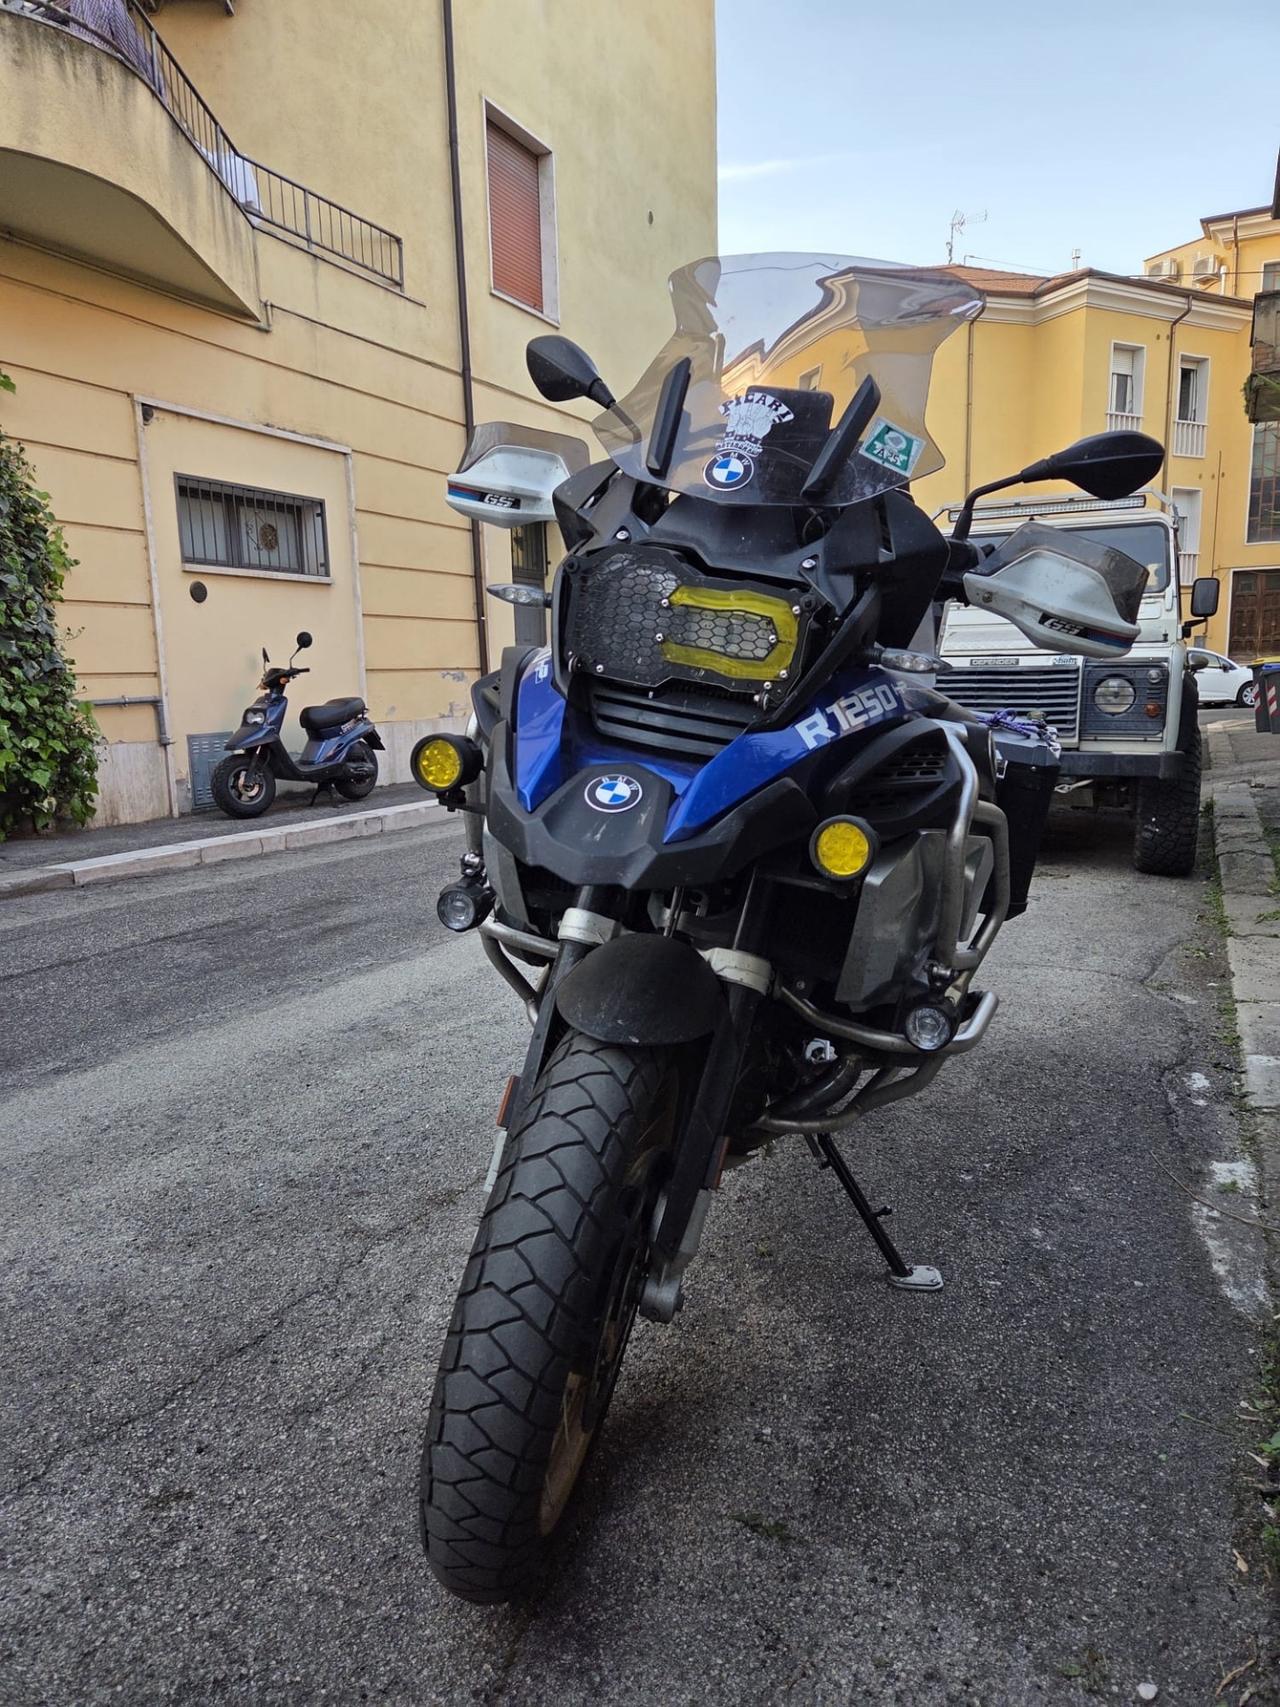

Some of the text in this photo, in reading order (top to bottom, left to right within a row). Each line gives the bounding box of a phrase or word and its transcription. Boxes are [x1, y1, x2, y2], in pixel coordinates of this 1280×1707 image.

[484, 493, 516, 507] GS
[1043, 618, 1085, 635] GS
[794, 707, 837, 750] R
[825, 684, 898, 731] 1250
[601, 774, 640, 791] BMW
